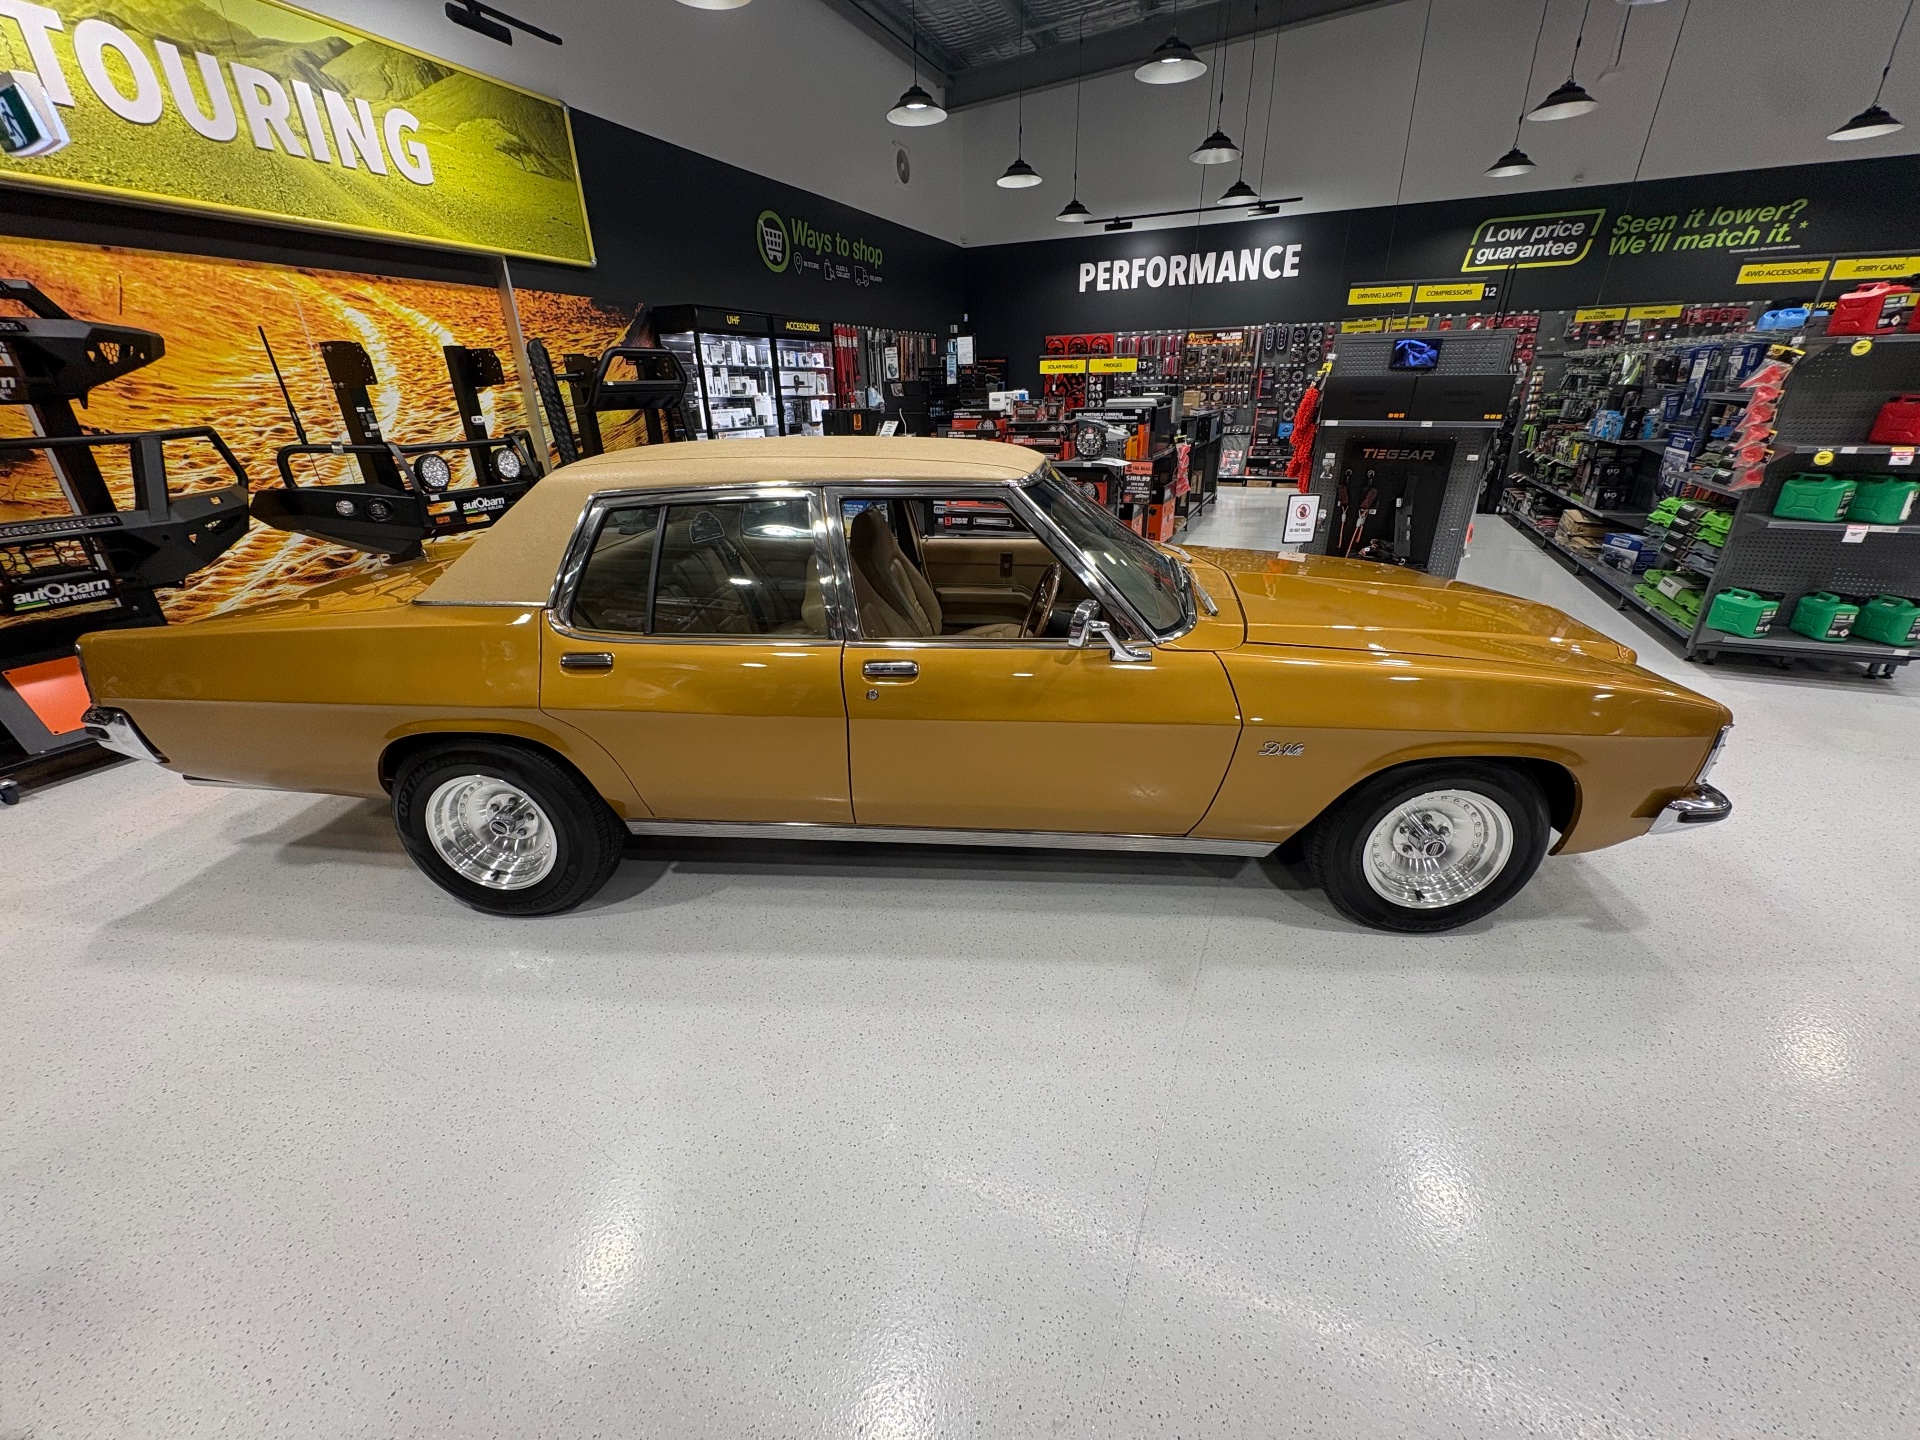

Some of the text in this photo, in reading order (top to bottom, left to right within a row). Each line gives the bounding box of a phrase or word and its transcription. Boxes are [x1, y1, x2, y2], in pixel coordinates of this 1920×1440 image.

[0, 0, 435, 186] TOURING
[1612, 198, 1809, 236] Seen it lower?
[1484, 220, 1586, 244] Low price
[790, 217, 883, 269] Ways to shop
[1608, 231, 1672, 256] We'll
[1672, 225, 1762, 250] match
[1474, 240, 1578, 265] guarantee
[1078, 243, 1302, 293] PERFORMANCE
[1765, 267, 1821, 277] ACCESSORIES
[1852, 263, 1906, 273] JERRY CANS
[1356, 291, 1403, 300] DRIVING LIGHTS
[1425, 288, 1474, 297] COMPRESSORS
[1484, 287, 1497, 297] 12
[726, 315, 741, 326] UHF
[785, 321, 821, 333] ACCESSORIES
[1138, 361, 1148, 369] 13
[1362, 448, 1436, 460] TIEGEAR
[49, 590, 108, 605] TEAM BURLEIGH
